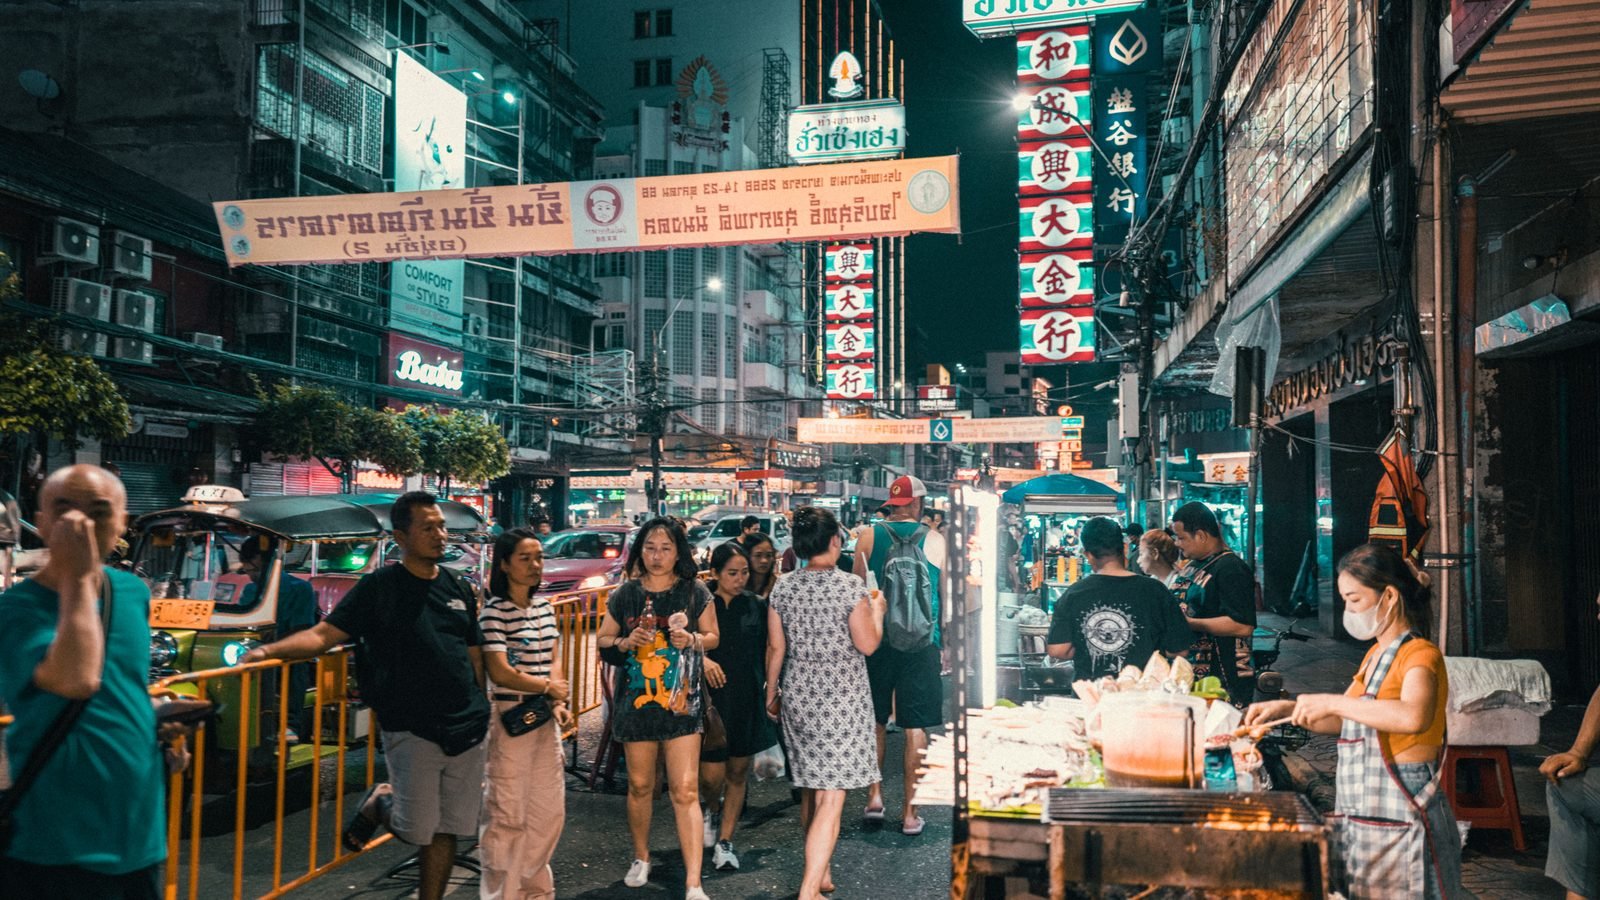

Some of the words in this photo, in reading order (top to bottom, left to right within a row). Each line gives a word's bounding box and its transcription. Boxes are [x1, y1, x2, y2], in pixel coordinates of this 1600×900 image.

[405, 263, 452, 292] COMFORT
[407, 283, 416, 292] OR
[416, 287, 450, 310] STYLE?
[838, 251, 862, 393] 興大金行
[395, 350, 464, 390] Bata
[192, 487, 227, 499] TAXI
